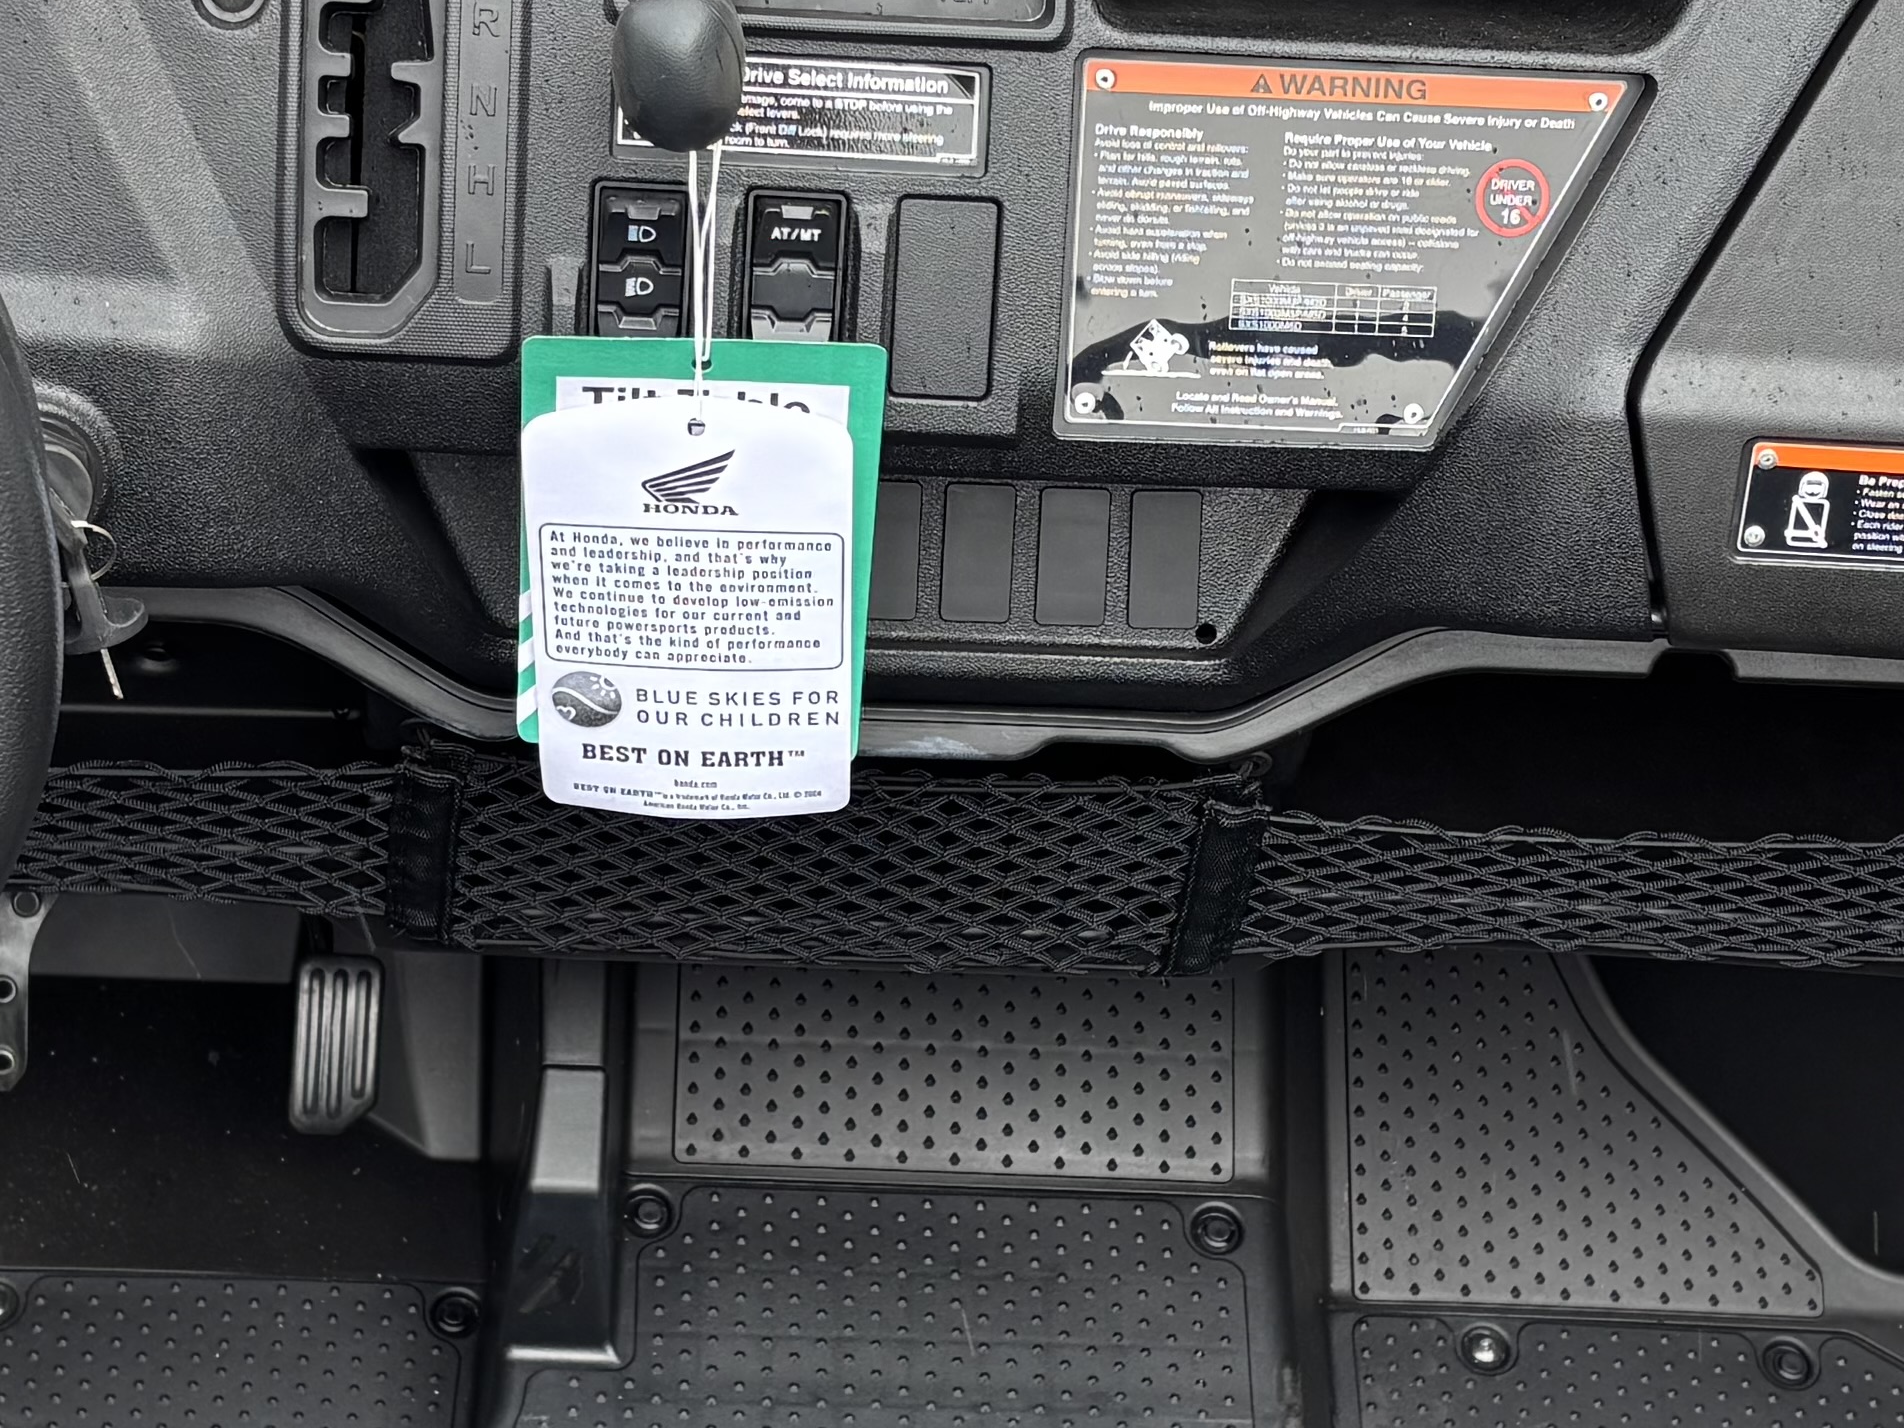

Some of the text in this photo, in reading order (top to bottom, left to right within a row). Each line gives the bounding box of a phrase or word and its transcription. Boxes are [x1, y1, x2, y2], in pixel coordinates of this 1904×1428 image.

[472, 4, 501, 37] R
[788, 68, 843, 89] Select
[847, 71, 949, 94] Information
[1279, 72, 1427, 101] WARNING
[469, 83, 498, 116] N
[1148, 100, 1576, 130] Improper Use of Off-Highway Vehicles Can Cause Severe Injury or Death
[1094, 122, 1204, 143] Drive Responsibly
[1284, 131, 1333, 147] Require
[1333, 133, 1375, 149] Proper
[1376, 135, 1401, 148] Use
[1402, 137, 1416, 149] of
[1417, 137, 1446, 149] Your
[467, 164, 496, 196] H
[1490, 178, 1536, 192] DRIVER
[1489, 193, 1533, 207] UNDER
[1500, 207, 1522, 226] 16
[770, 226, 822, 242] AT/MT
[465, 241, 492, 274] L
[1210, 392, 1231, 403] and
[1274, 406, 1295, 418] and
[1858, 474, 1877, 486] Be
[642, 502, 739, 517] HONDA
[549, 529, 832, 552] At Honda, we believe in performance
[550, 545, 787, 567] and leadership, and that's why
[550, 559, 813, 581] we're taking a leadership position
[551, 573, 818, 594] when it comes to the environment.
[552, 586, 834, 609] We continue to develop low-emission
[553, 600, 801, 622] technologies for our current and
[553, 614, 775, 637] future powersports products.
[555, 628, 821, 651] And that's the kind of performance
[555, 644, 752, 664] everybody can appreciate.
[635, 688, 839, 707] BLUE SKIES FOR
[636, 709, 839, 728] OUR CHILDREN
[581, 742, 648, 765] BEST
[657, 748, 690, 768] ON
